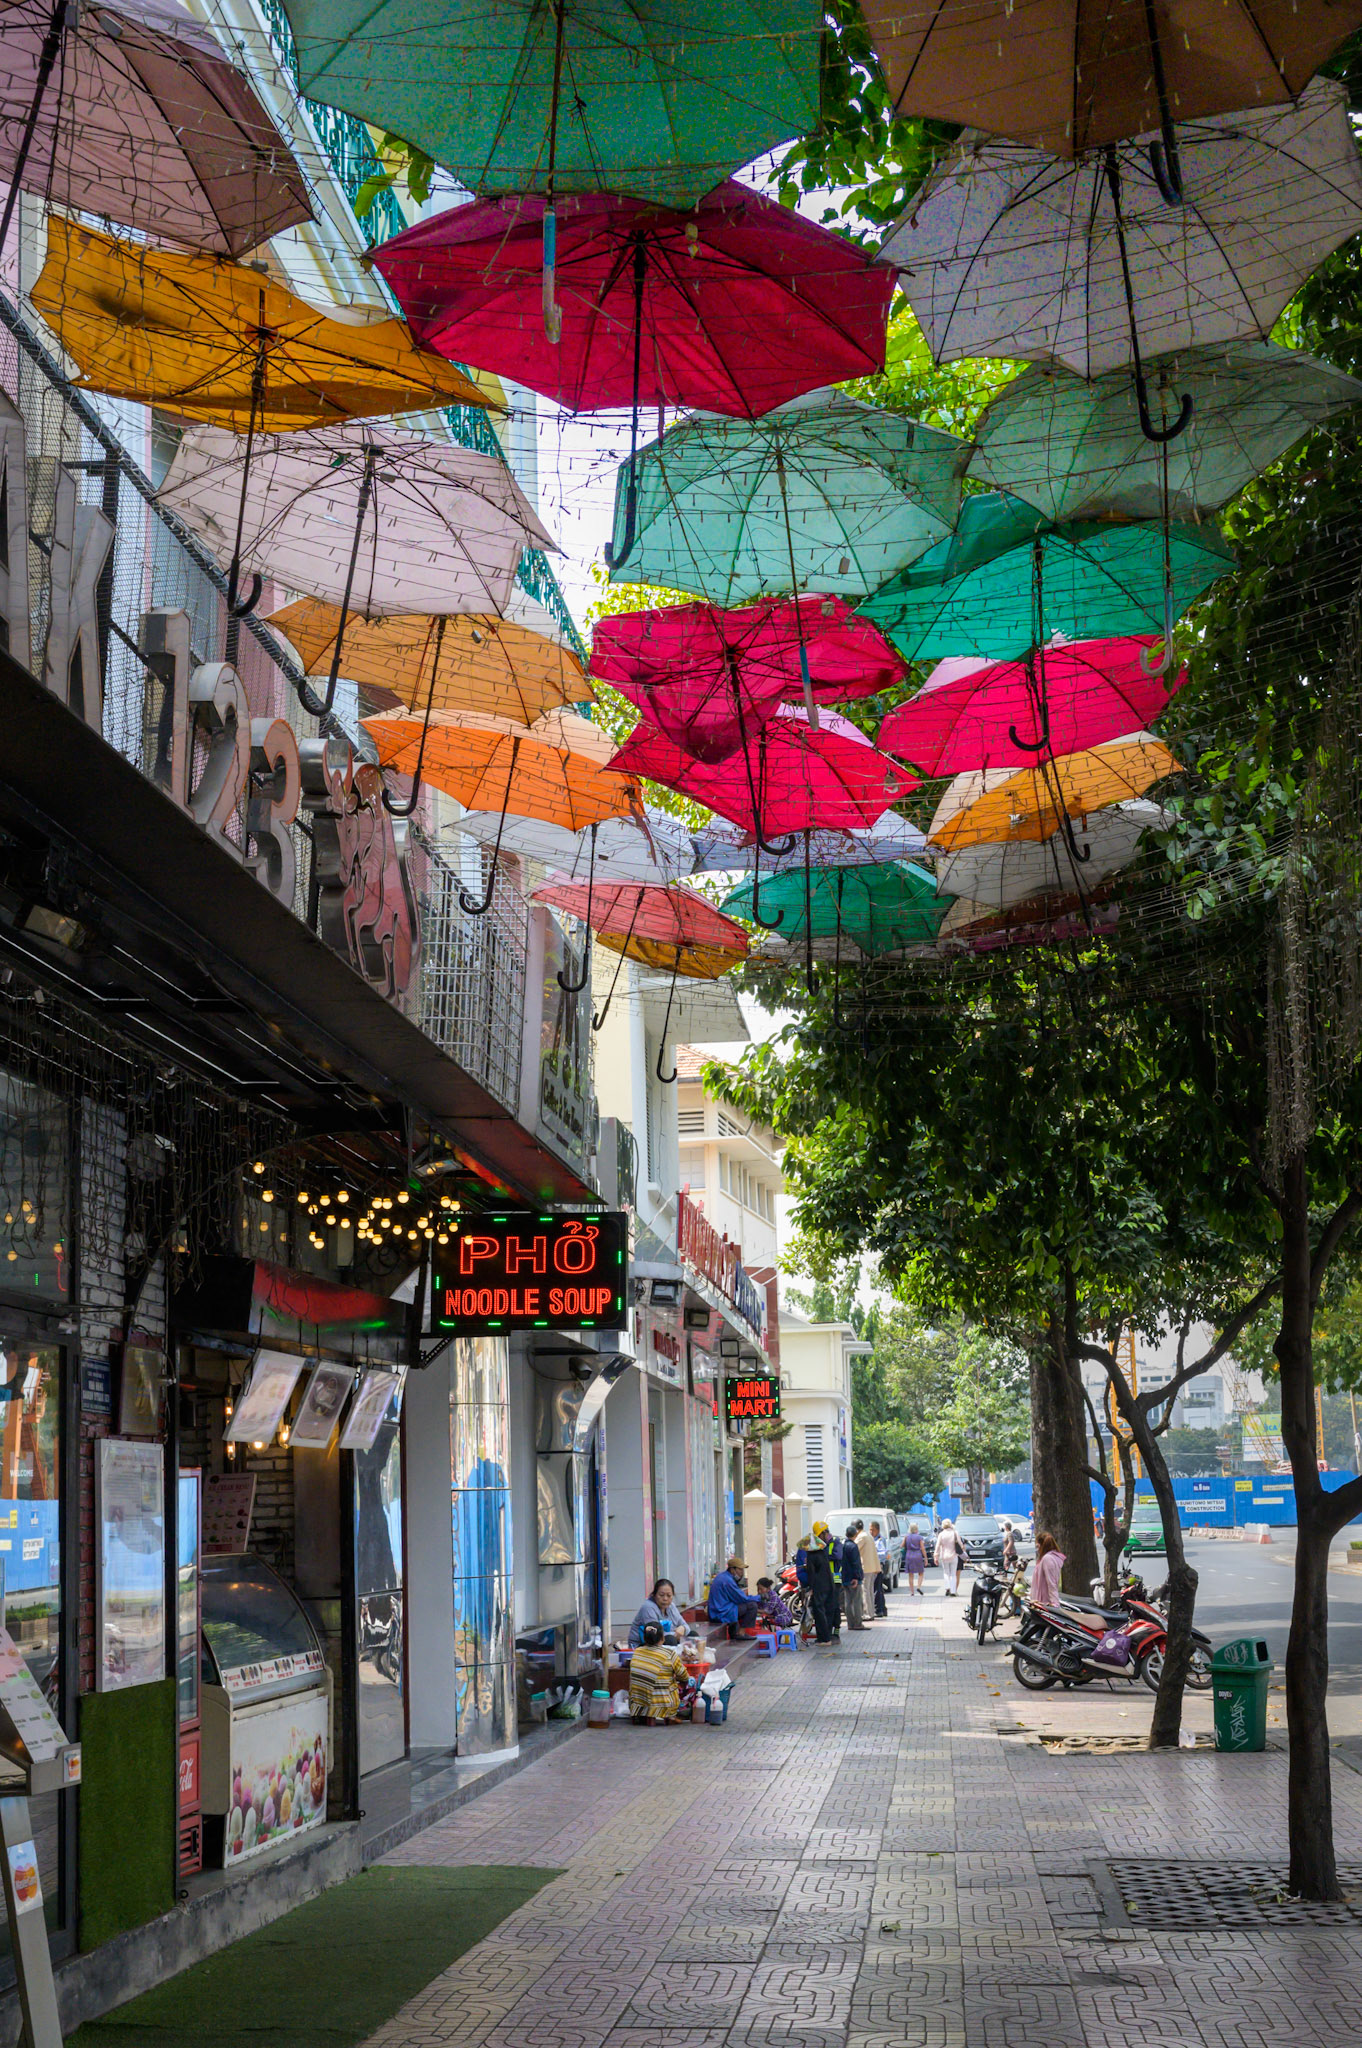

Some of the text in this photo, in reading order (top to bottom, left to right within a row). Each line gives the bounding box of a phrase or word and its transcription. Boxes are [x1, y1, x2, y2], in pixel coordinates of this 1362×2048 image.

[142, 606, 301, 909] 123
[460, 1221, 599, 1274] PHỞ
[445, 1287, 612, 1316] NOODLE SOUP
[737, 1381, 770, 1398] MINI
[730, 1399, 776, 1416] MART
[10, 1469, 34, 1477] WELCOME
